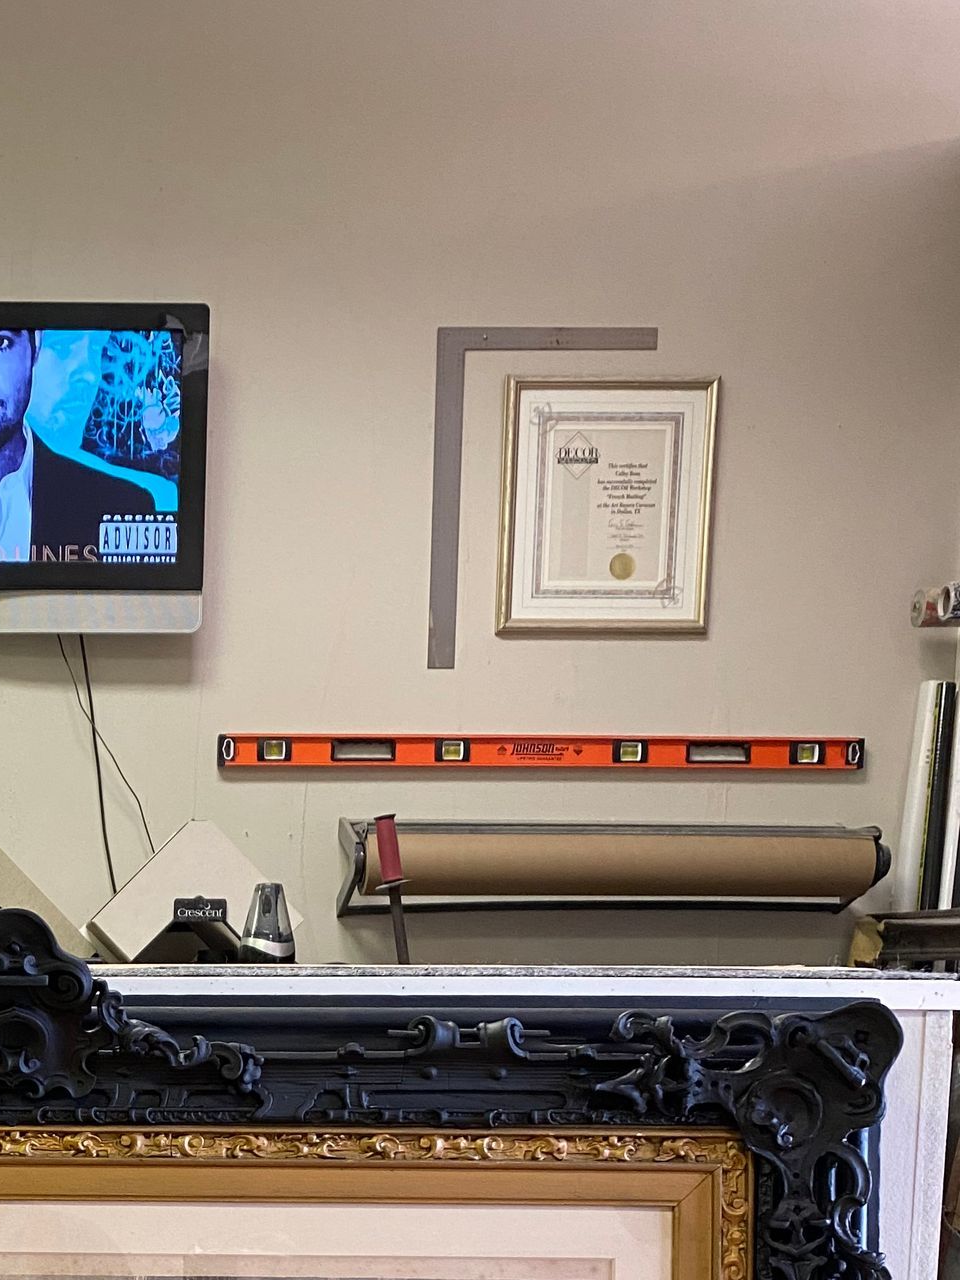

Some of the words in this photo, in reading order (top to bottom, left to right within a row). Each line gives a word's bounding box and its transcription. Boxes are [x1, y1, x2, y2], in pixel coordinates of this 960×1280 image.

[558, 447, 599, 458] DECOR
[103, 526, 172, 550] ADVISOR
[510, 743, 556, 756] JOHNSON
[177, 907, 223, 917] Crescent
